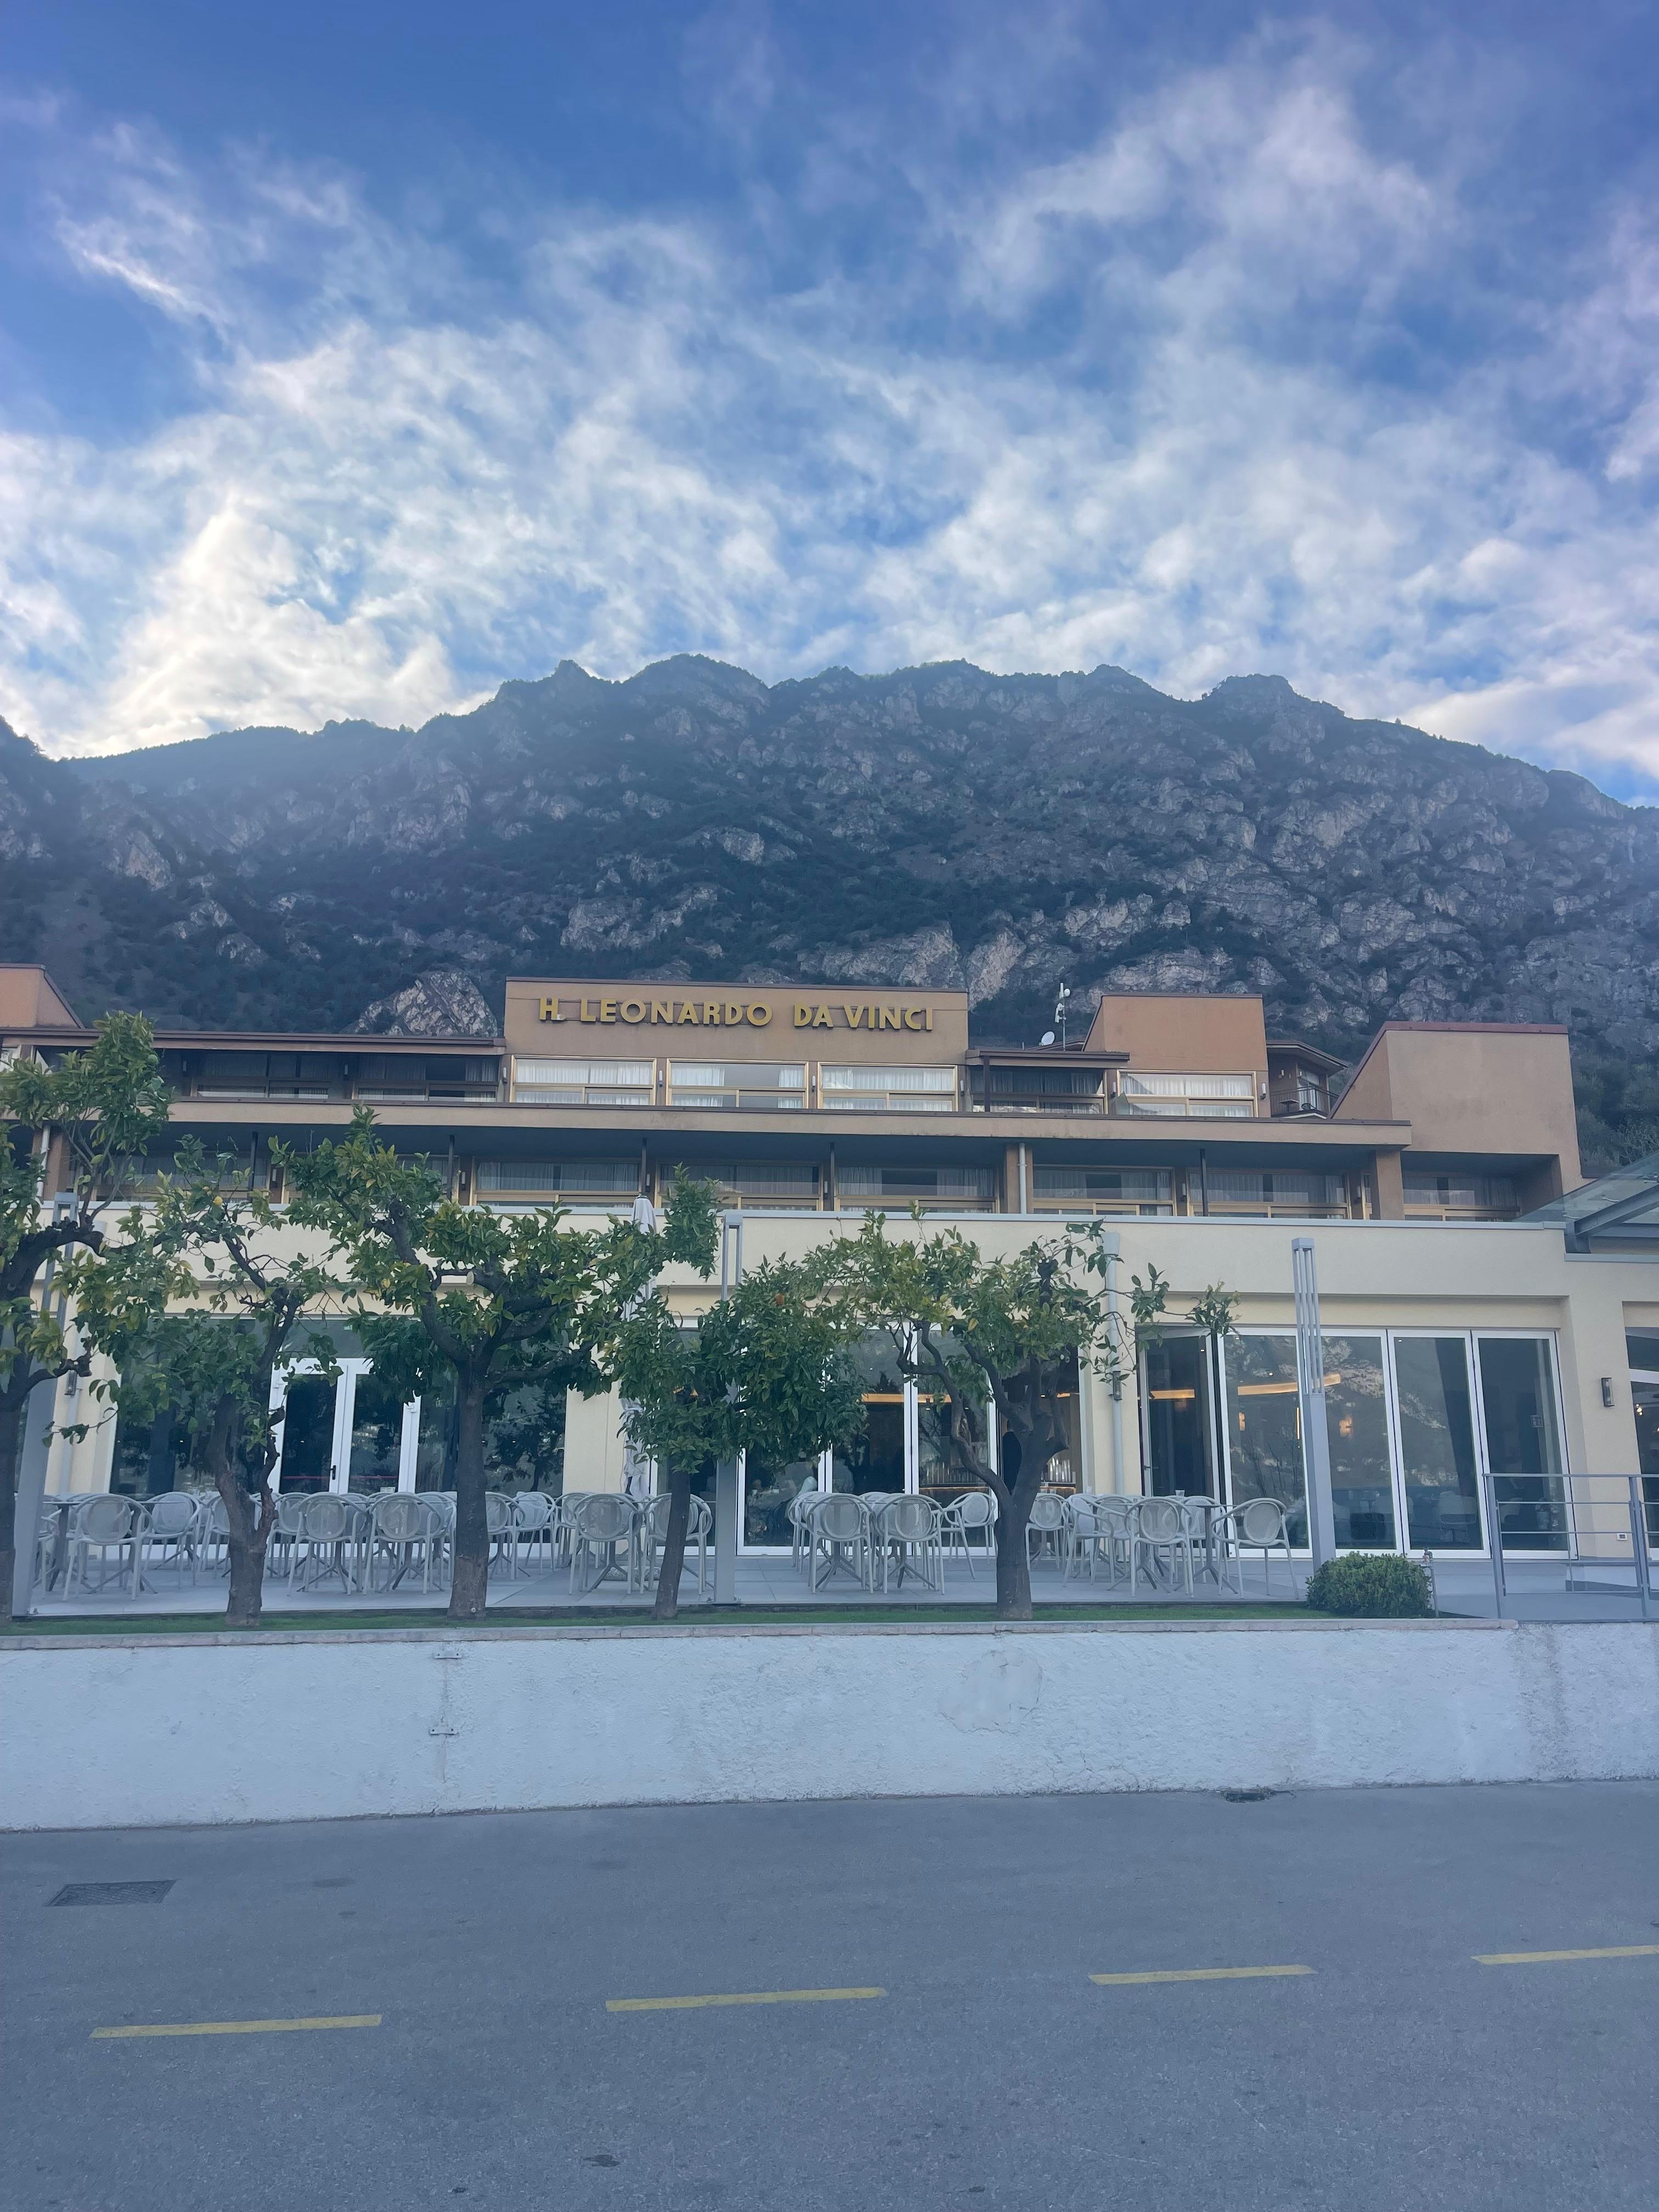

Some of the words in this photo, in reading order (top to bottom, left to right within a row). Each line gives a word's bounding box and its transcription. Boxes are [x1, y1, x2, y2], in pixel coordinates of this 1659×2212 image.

[580, 998, 772, 1026] LEONARDO
[794, 1003, 833, 1028] DA
[843, 1005, 933, 1031] VINCI
